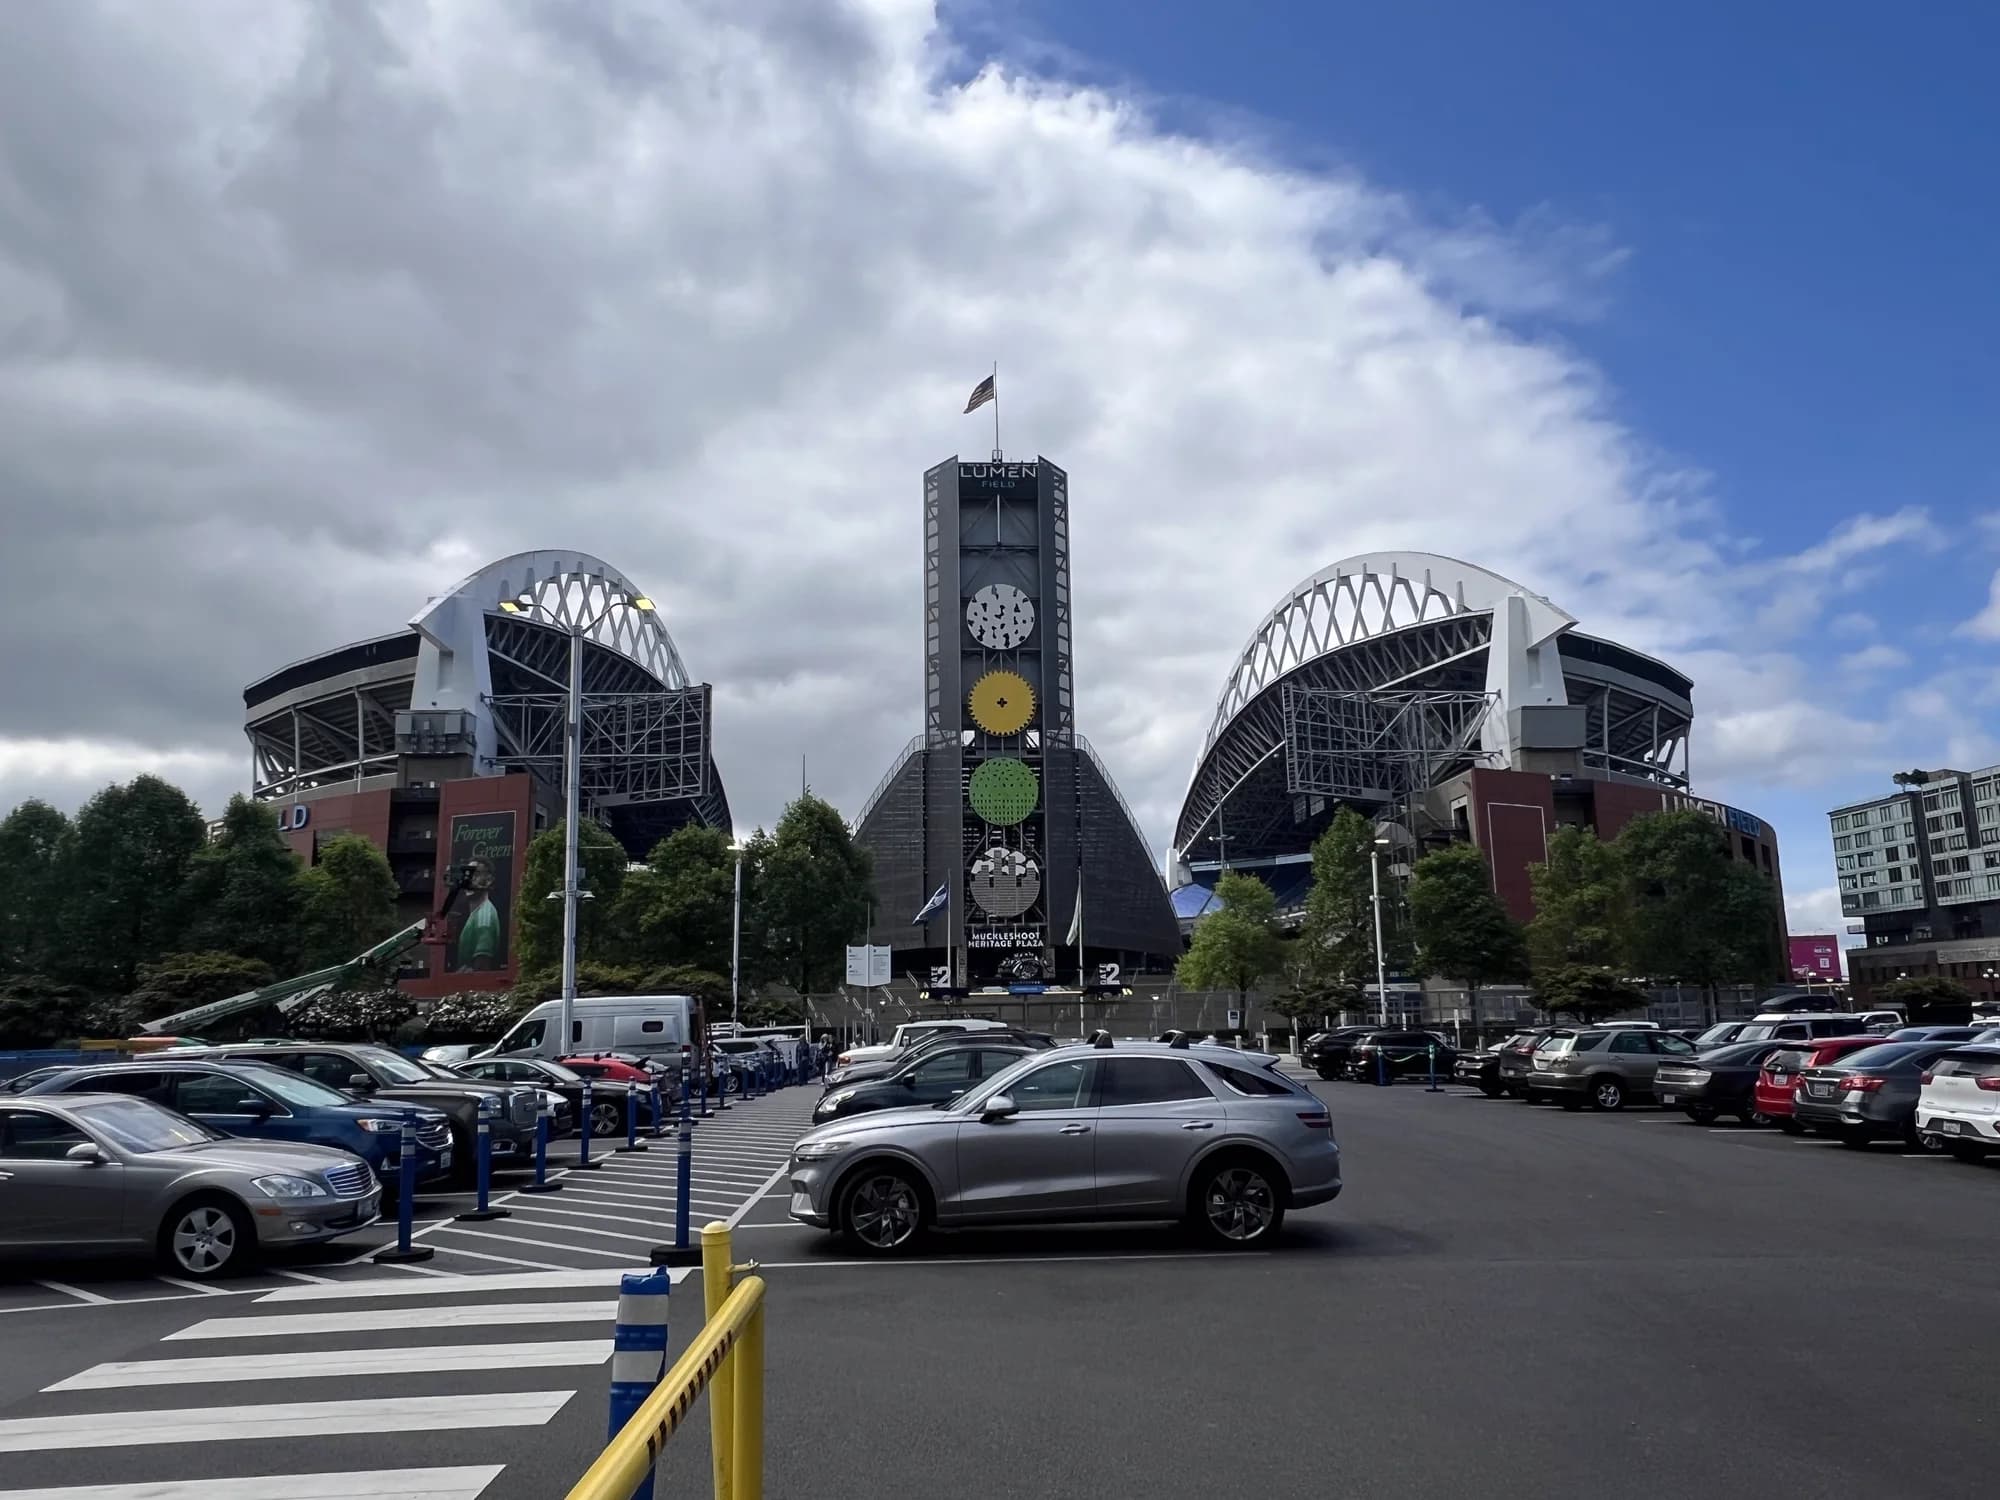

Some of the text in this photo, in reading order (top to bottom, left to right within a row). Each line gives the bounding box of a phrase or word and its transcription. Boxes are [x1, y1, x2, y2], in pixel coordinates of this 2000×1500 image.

[960, 466, 1036, 478] LUMEN
[982, 480, 1016, 488] FIELD
[1727, 808, 1761, 837] FIELD
[454, 824, 504, 843] Forever
[472, 841, 512, 858] Green
[967, 940, 1044, 948] HERITAGE PLAZA
[972, 932, 1041, 940] MUCKLESHOOT
[937, 966, 951, 988] 2
[1106, 963, 1120, 985] 2
